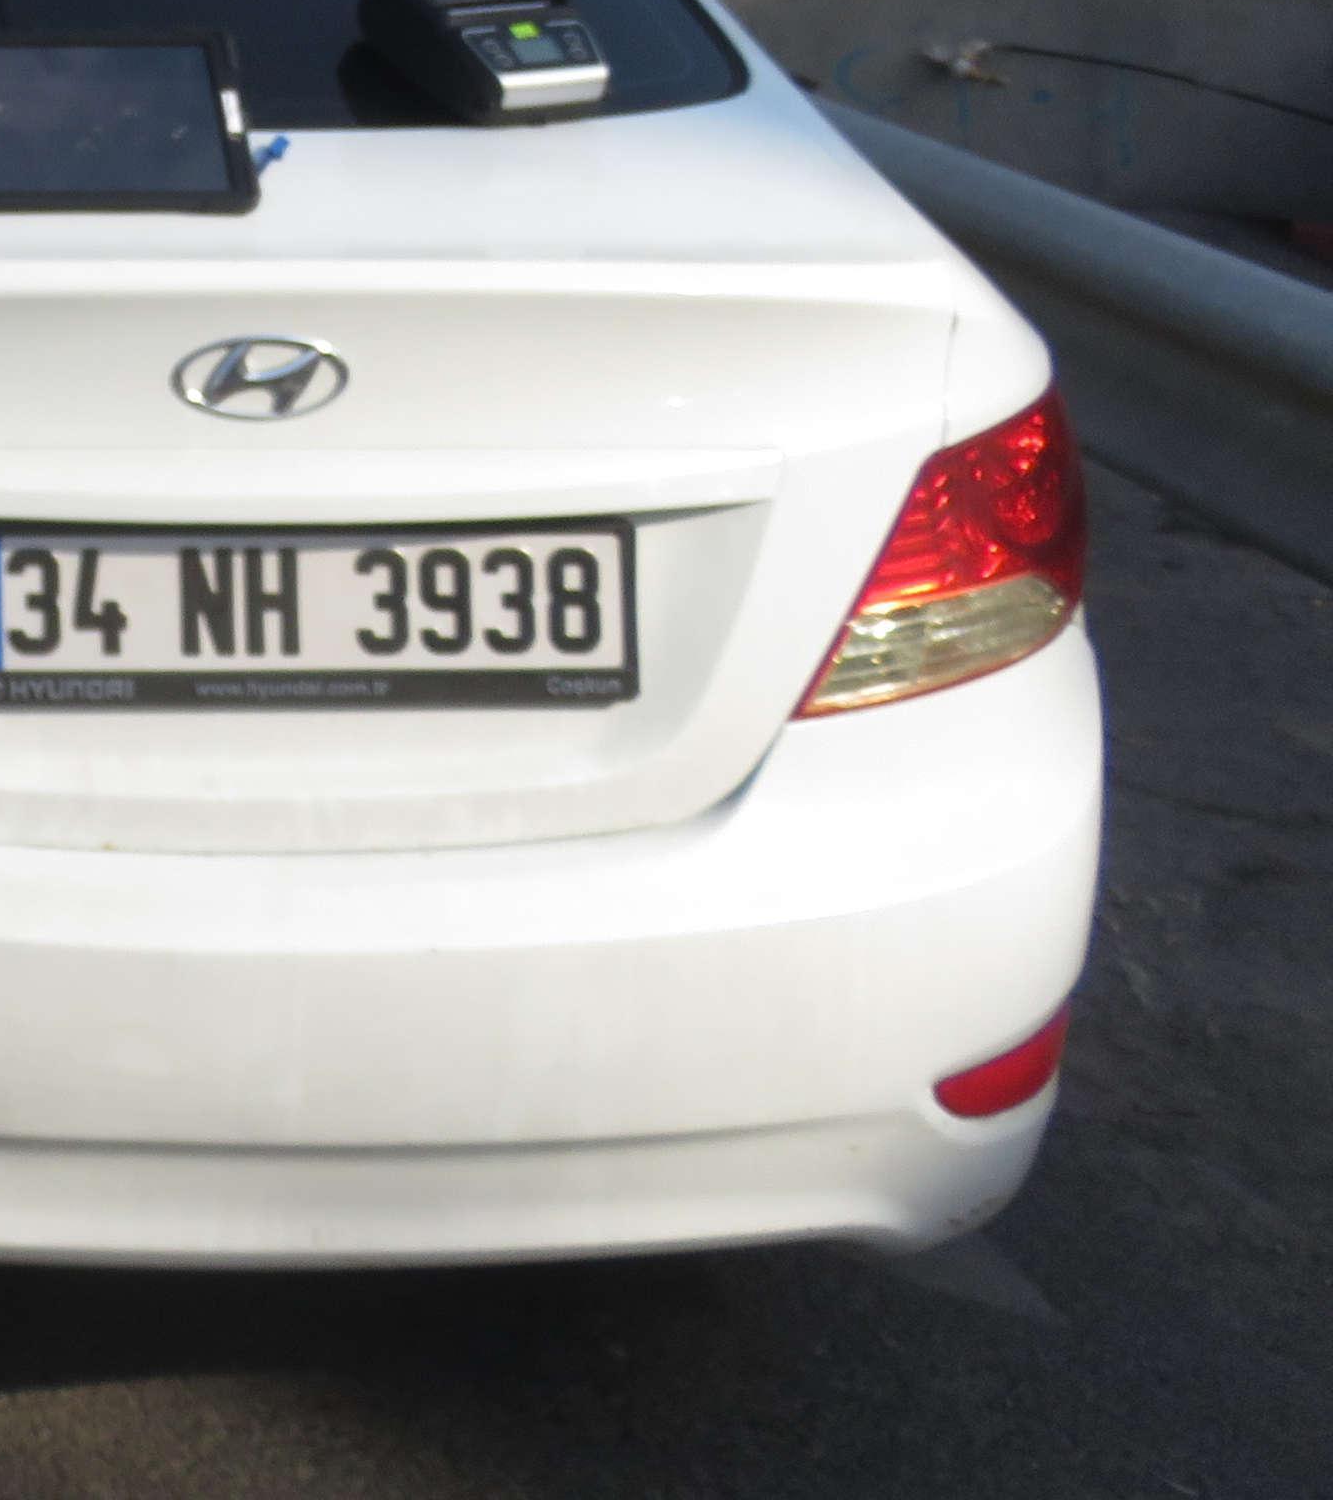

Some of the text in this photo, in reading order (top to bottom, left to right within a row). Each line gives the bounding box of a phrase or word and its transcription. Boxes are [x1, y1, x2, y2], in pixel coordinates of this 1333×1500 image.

[6, 546, 601, 656] 34 NH 3938
[9, 677, 135, 700] HYUNDAI
